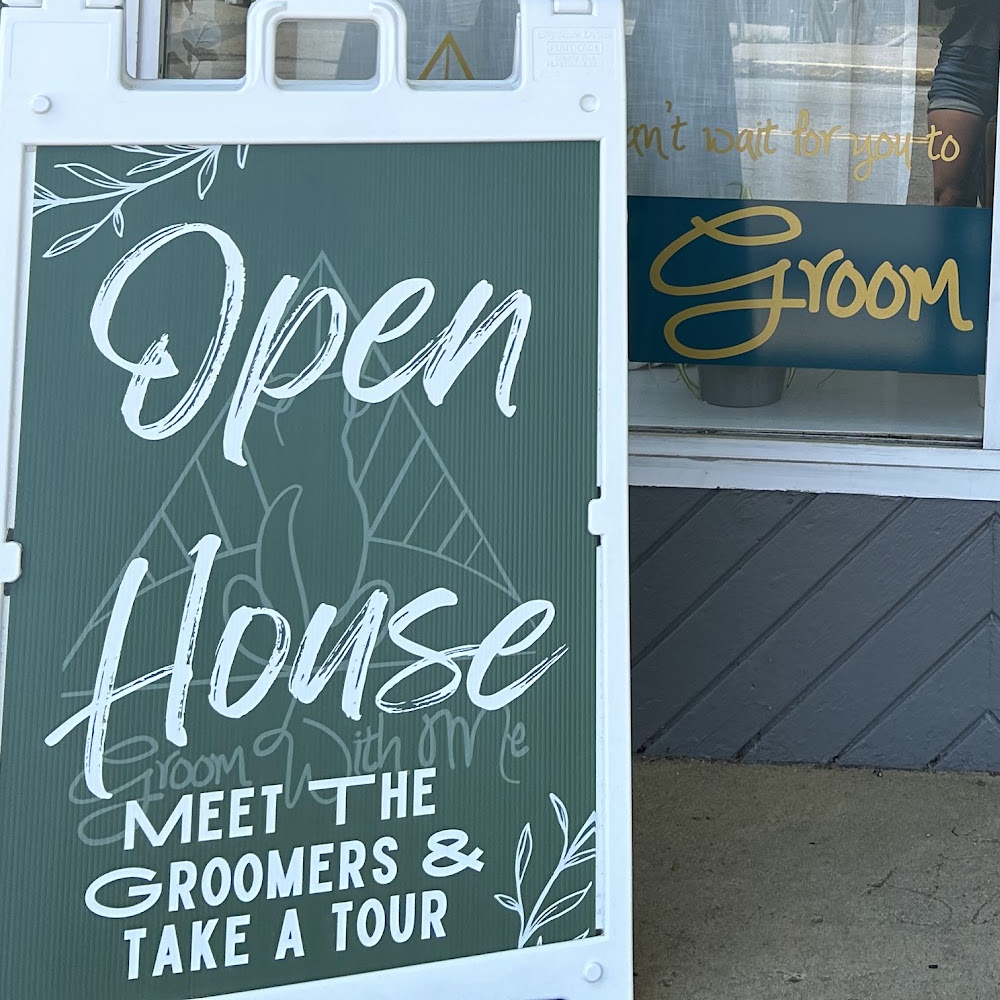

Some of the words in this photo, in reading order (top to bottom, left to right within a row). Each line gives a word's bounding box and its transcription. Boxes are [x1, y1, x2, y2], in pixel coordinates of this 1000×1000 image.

[626, 100, 688, 161] an't
[702, 118, 779, 161] wait
[791, 108, 842, 158] for
[849, 131, 912, 182] you
[926, 124, 960, 162] to
[650, 205, 974, 360] Groom
[90, 222, 532, 467] Open
[45, 533, 569, 800] House
[68, 735, 251, 846] Groom
[123, 784, 284, 850] MEET
[308, 767, 437, 826] THE
[85, 835, 398, 918] GROOMERS
[420, 829, 484, 877] &
[123, 914, 250, 980] TAKE
[275, 921, 304, 961] A
[332, 890, 448, 953] TOUR
